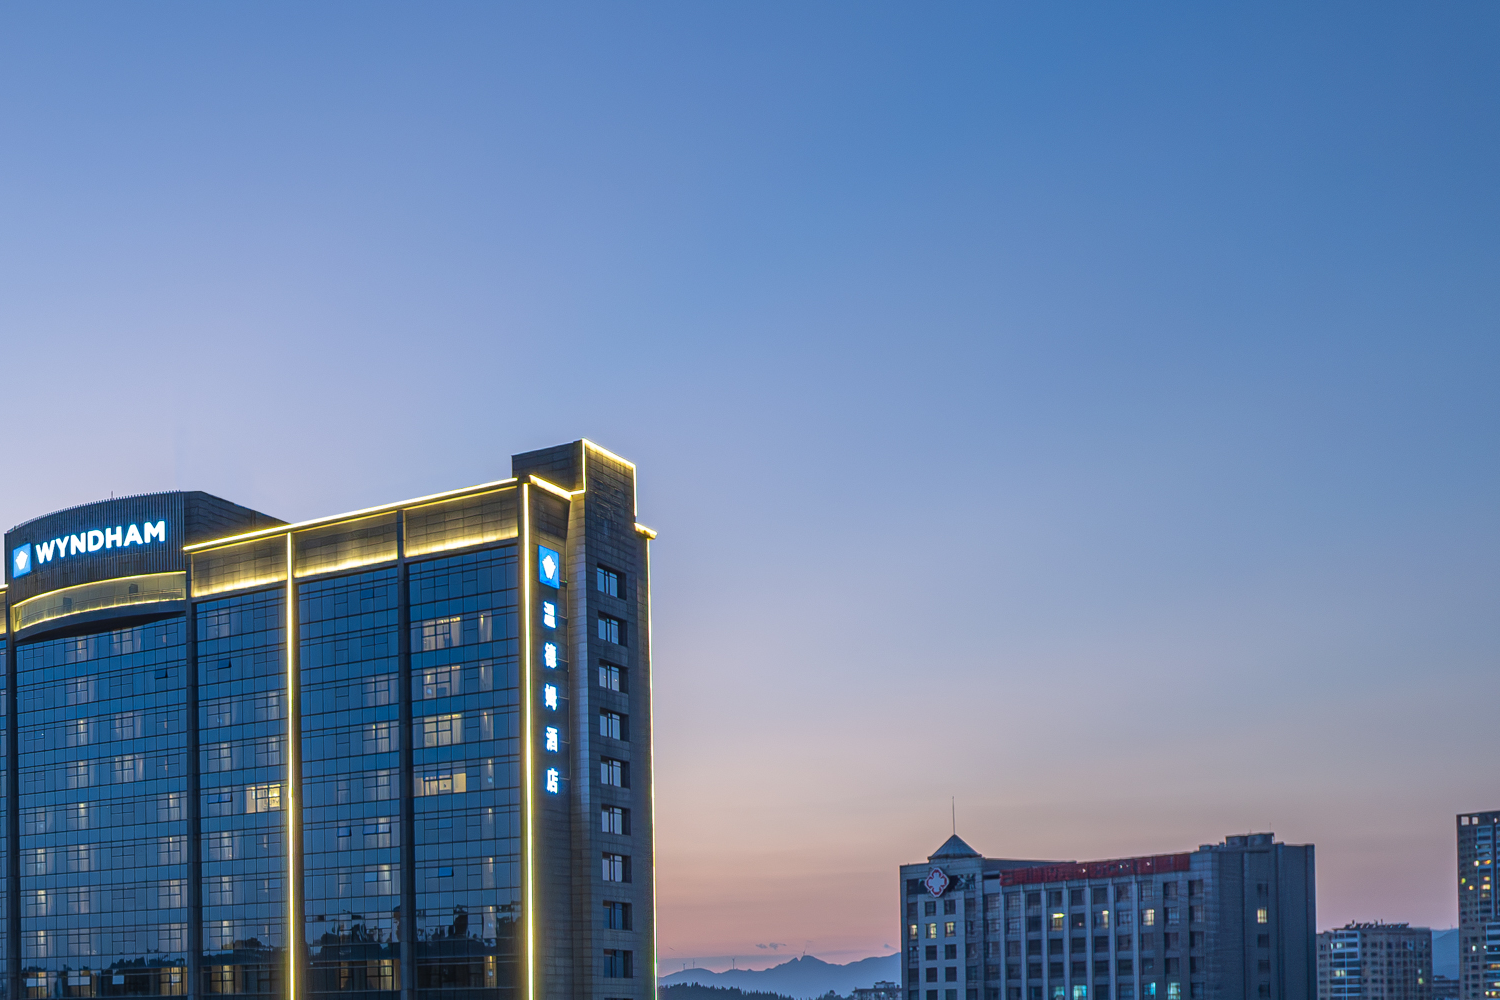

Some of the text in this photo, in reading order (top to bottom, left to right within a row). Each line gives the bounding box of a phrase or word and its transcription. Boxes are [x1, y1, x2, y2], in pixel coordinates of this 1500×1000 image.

[35, 520, 166, 564] WYNDHAM
[543, 600, 559, 794] 温德姆酒店
